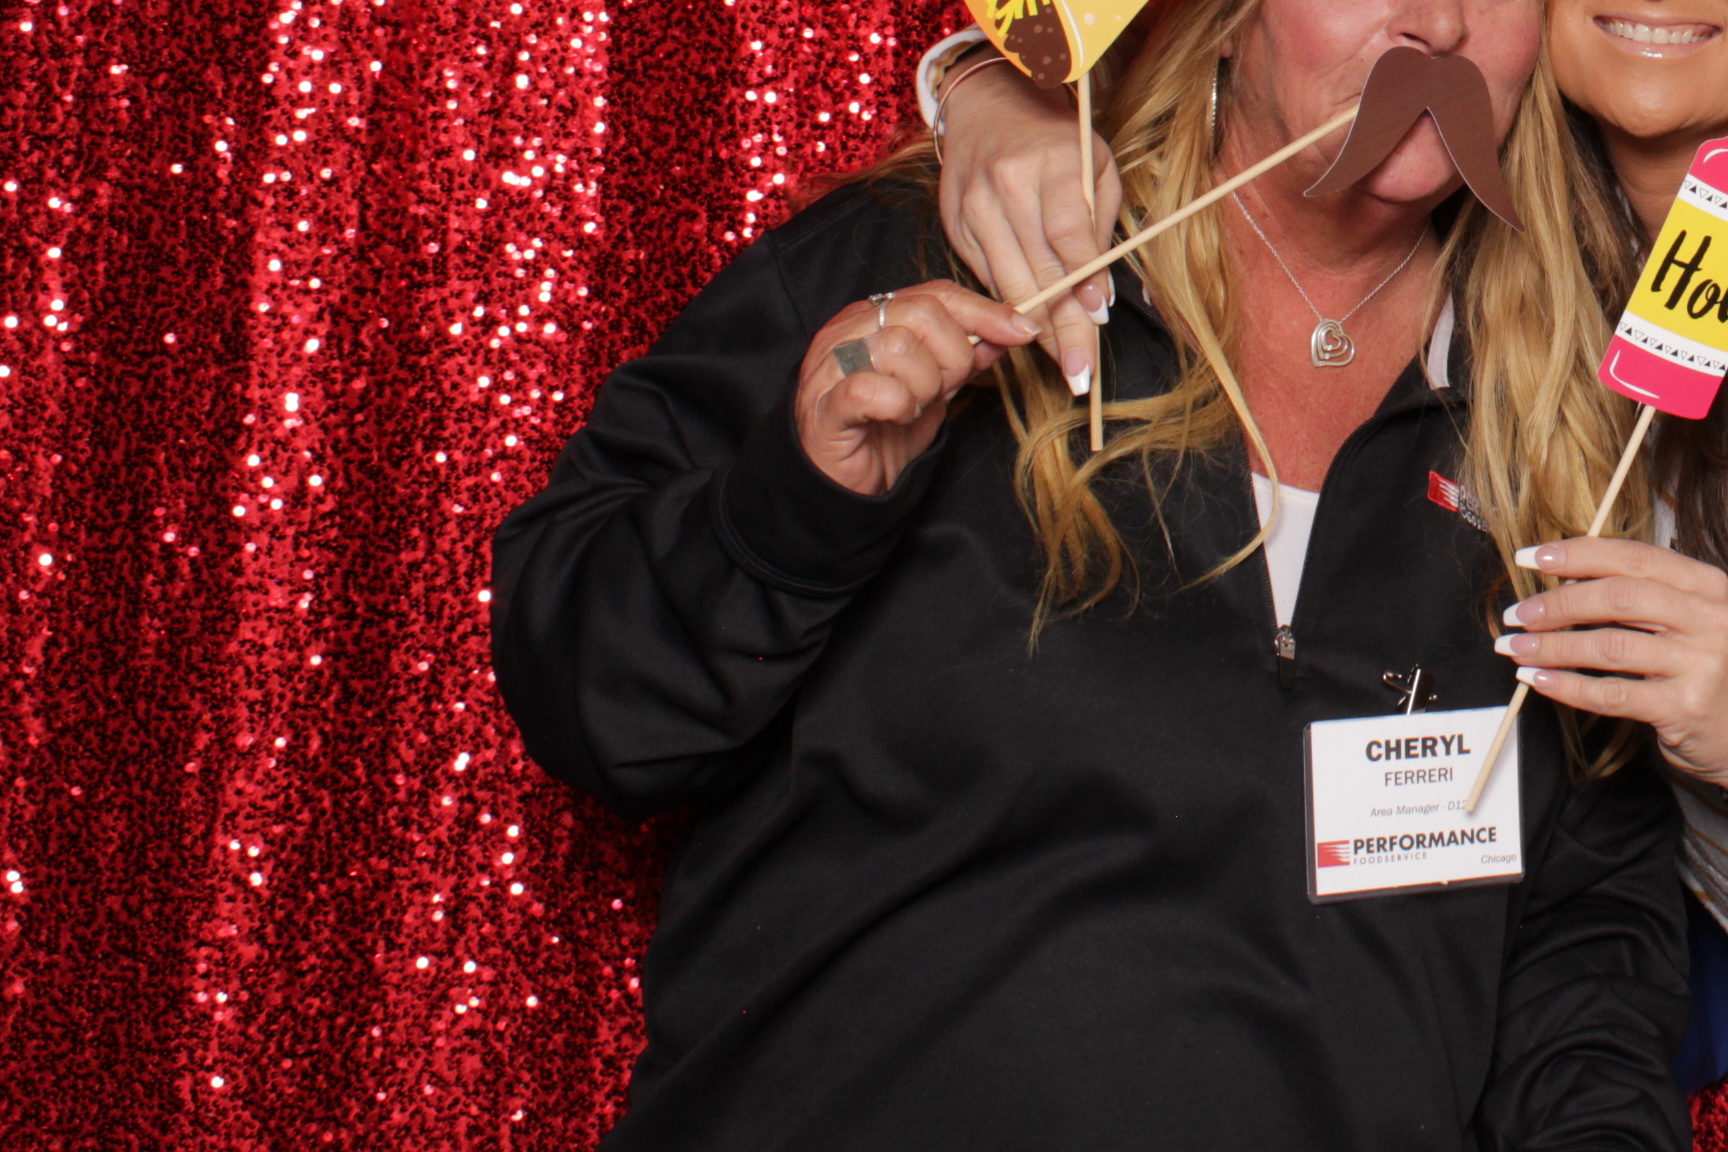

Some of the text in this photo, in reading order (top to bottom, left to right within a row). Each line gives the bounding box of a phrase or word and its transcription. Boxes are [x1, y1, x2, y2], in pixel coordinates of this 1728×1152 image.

[1365, 733, 1471, 762] CHERYL
[1384, 767, 1453, 787] FERRERI
[1370, 805, 1393, 818] Area
[1395, 803, 1439, 816] Manager
[1353, 826, 1497, 855] PERFORMANCE
[1353, 851, 1428, 865] FOODSERVICE
[1480, 854, 1517, 865] Chicago
